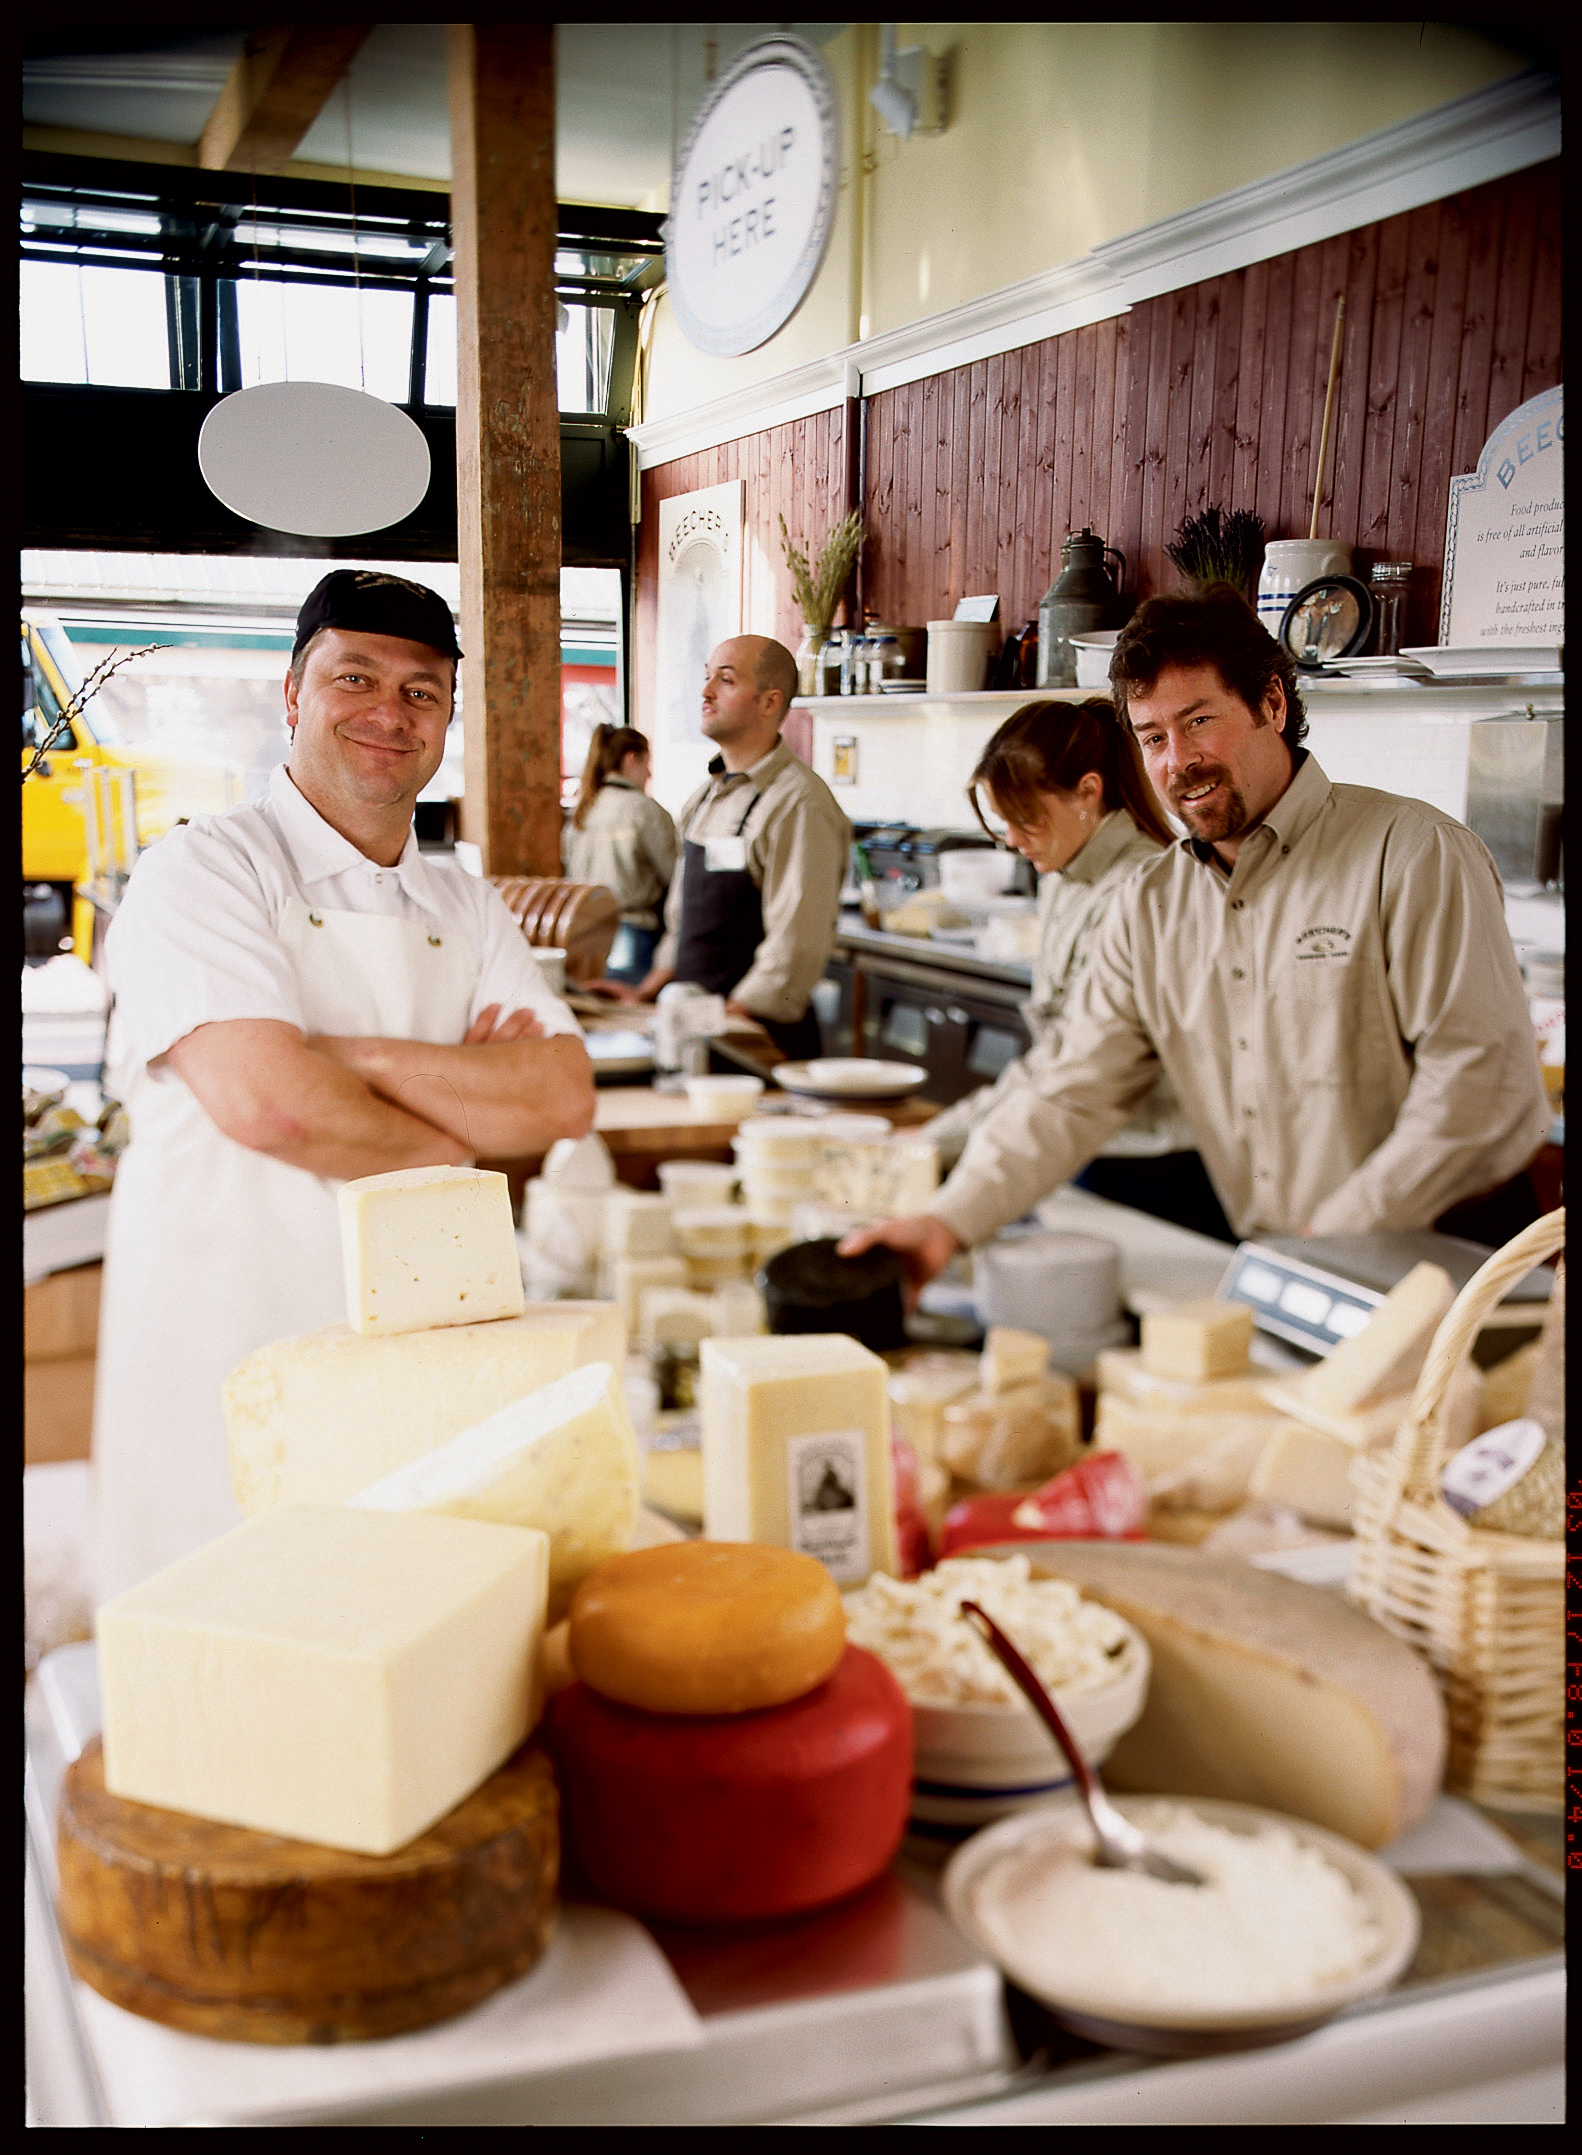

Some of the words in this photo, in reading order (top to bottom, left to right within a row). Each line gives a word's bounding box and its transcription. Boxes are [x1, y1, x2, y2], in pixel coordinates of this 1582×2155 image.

[697, 126, 794, 221] PICK-UP
[712, 197, 777, 267] HERE
[1511, 500, 1533, 516] Food
[1477, 530, 1484, 542] is
[1484, 528, 1502, 543] free
[1502, 525, 1513, 541] of
[1513, 524, 1526, 538] all
[1526, 519, 1564, 538] artificial
[1519, 544, 1537, 558] and
[1496, 581, 1509, 593] It's
[1510, 580, 1527, 594] just
[1495, 598, 1546, 614] handcrafted
[1546, 599, 1556, 611] in
